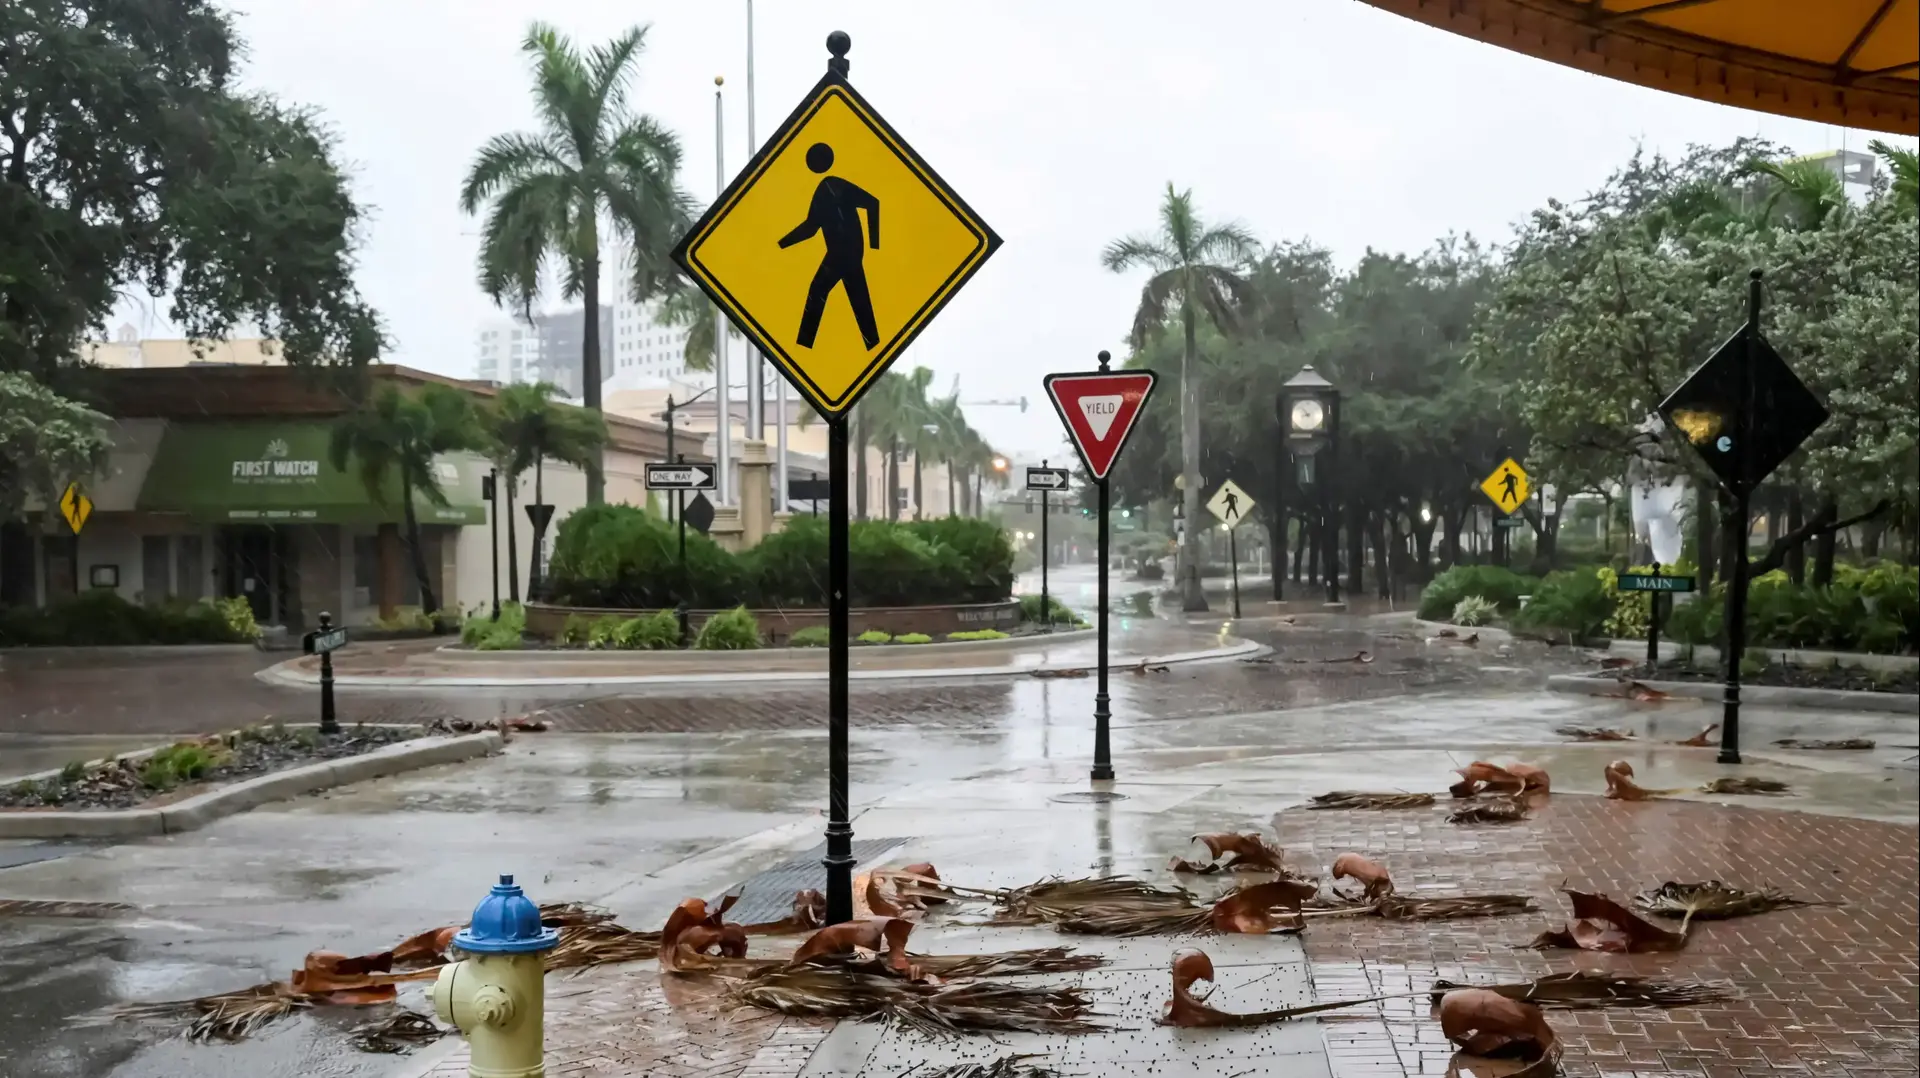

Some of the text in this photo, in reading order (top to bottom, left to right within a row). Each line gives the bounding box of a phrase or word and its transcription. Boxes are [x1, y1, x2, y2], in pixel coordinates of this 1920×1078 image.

[1086, 402, 1115, 414] YIELD
[232, 461, 318, 476] FIRST WATCH
[652, 473, 692, 481] ONE WAY
[1636, 577, 1673, 588] MAIN
